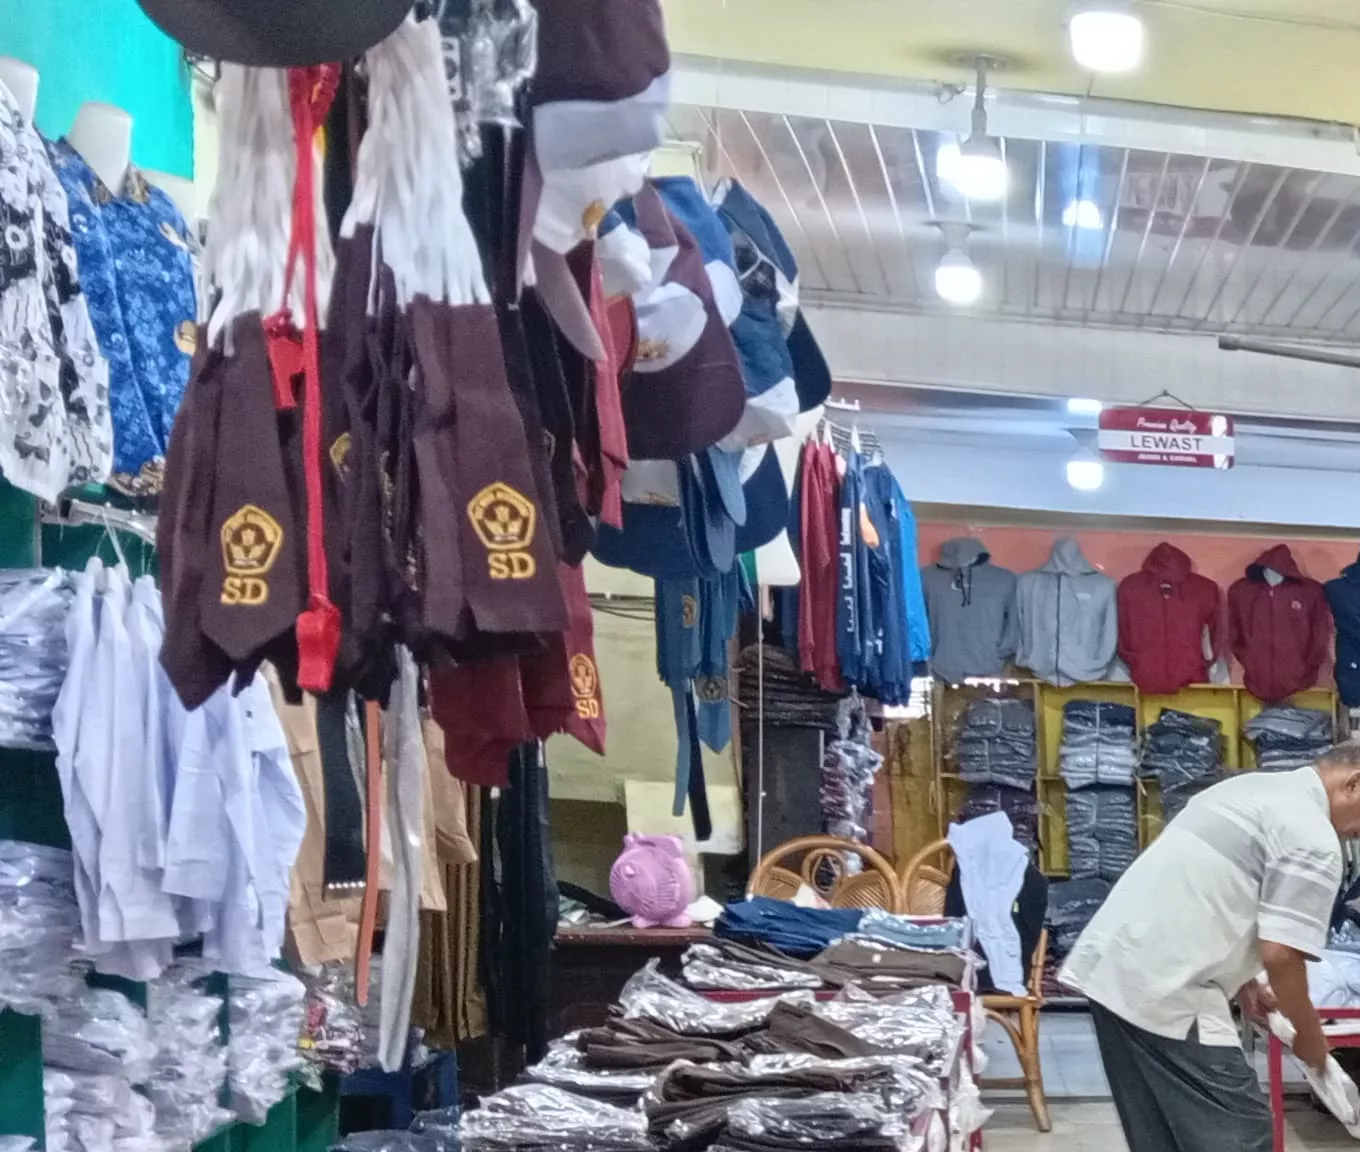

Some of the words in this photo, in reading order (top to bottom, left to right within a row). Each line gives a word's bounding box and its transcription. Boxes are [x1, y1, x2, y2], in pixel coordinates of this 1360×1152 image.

[1130, 434, 1203, 451] LEWAST
[487, 552, 536, 580] SD
[220, 576, 269, 605] SD
[576, 699, 599, 719] SD
